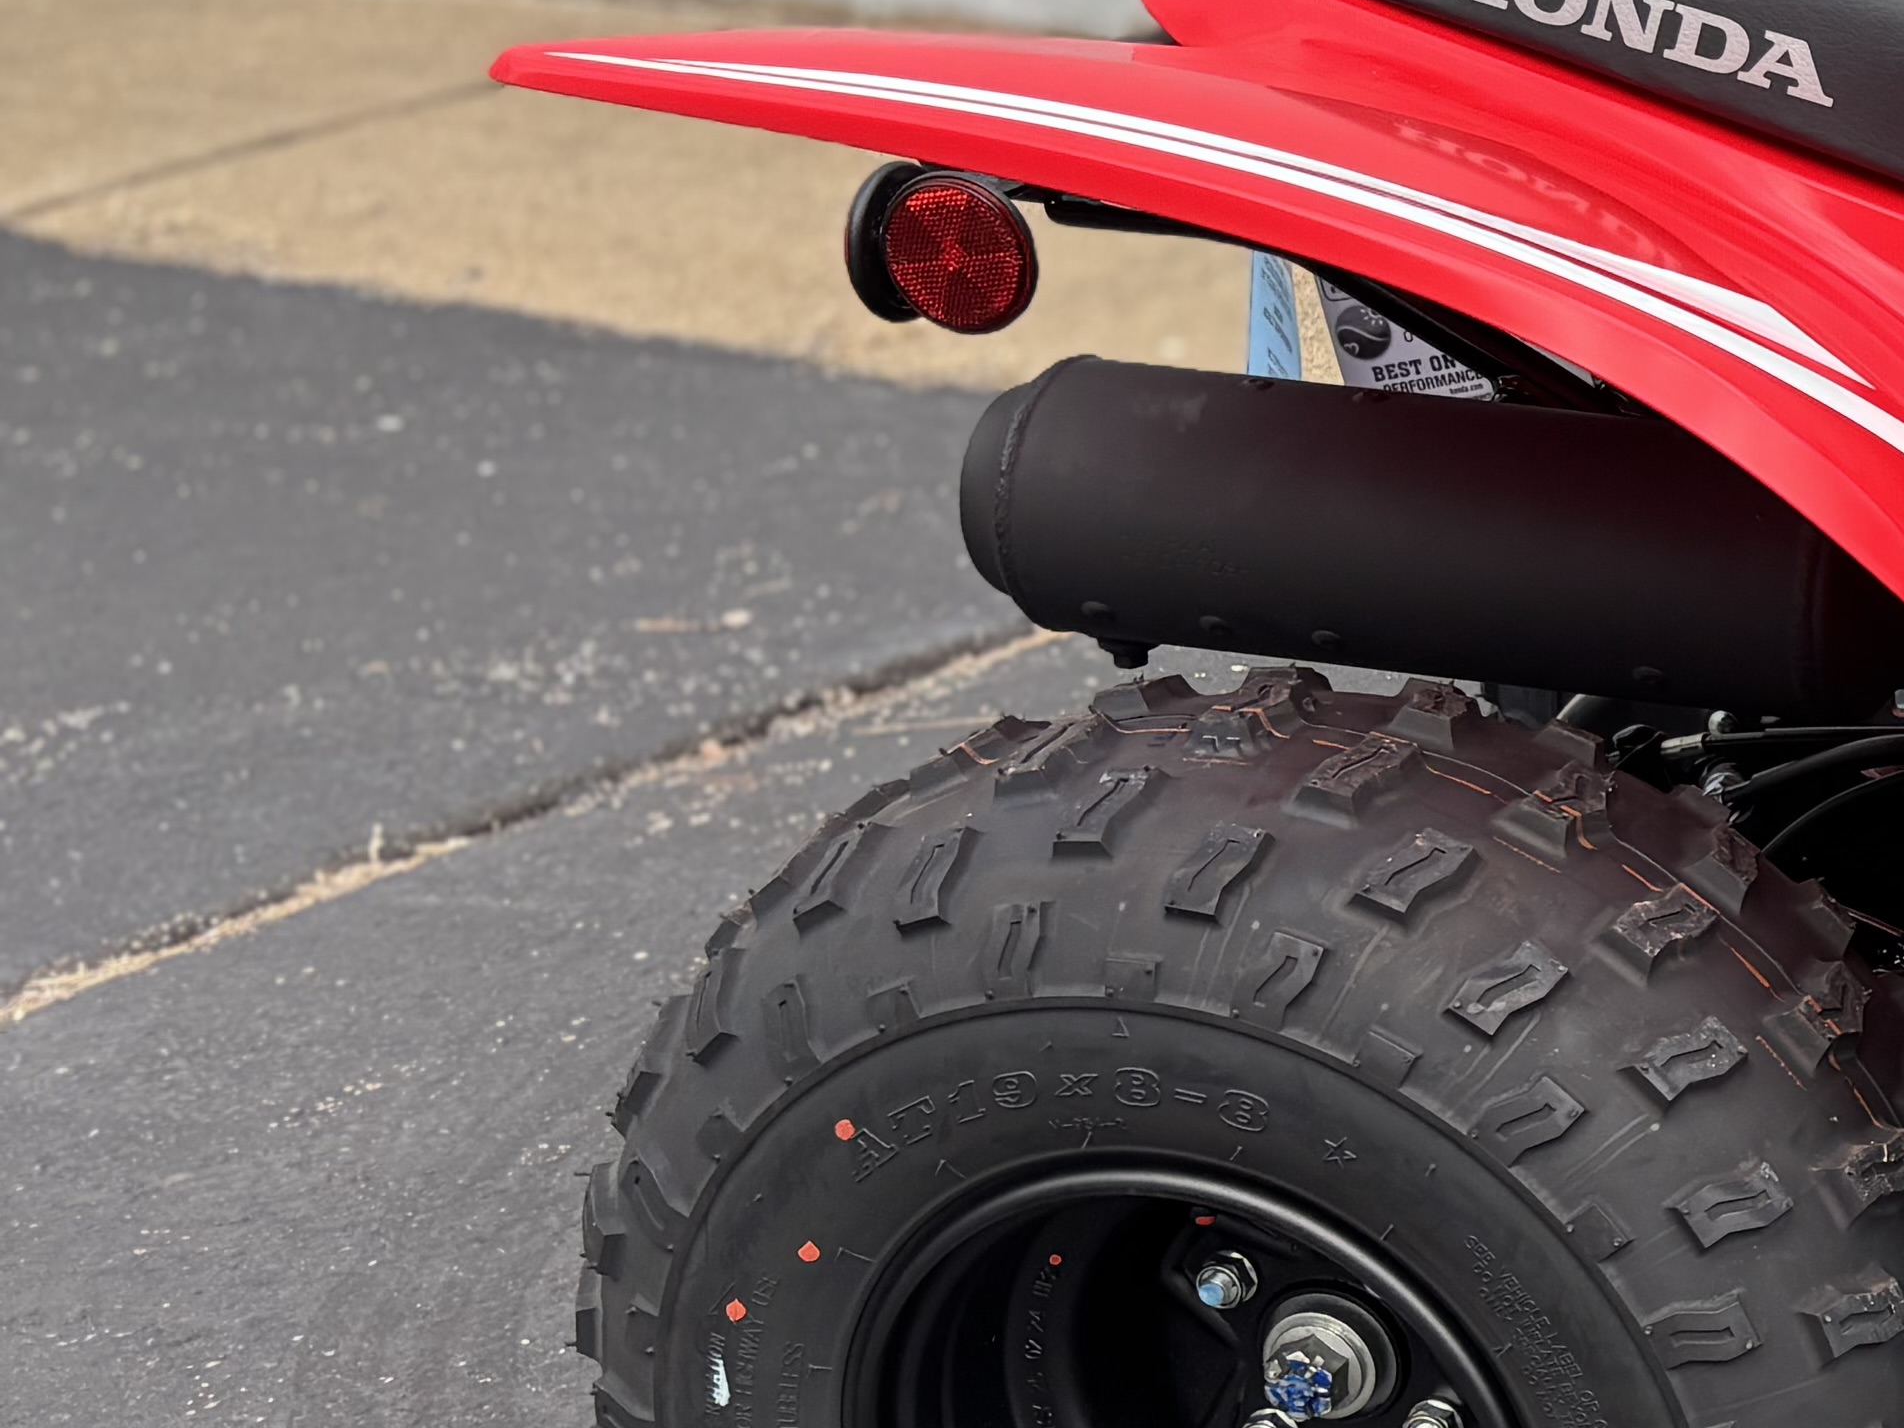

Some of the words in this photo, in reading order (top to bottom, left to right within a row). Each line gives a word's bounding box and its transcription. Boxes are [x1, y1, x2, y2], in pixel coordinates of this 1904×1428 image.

[1371, 358, 1422, 383] BEST
[1461, 1231, 1497, 1266] SEE
[750, 1269, 781, 1308] USE
